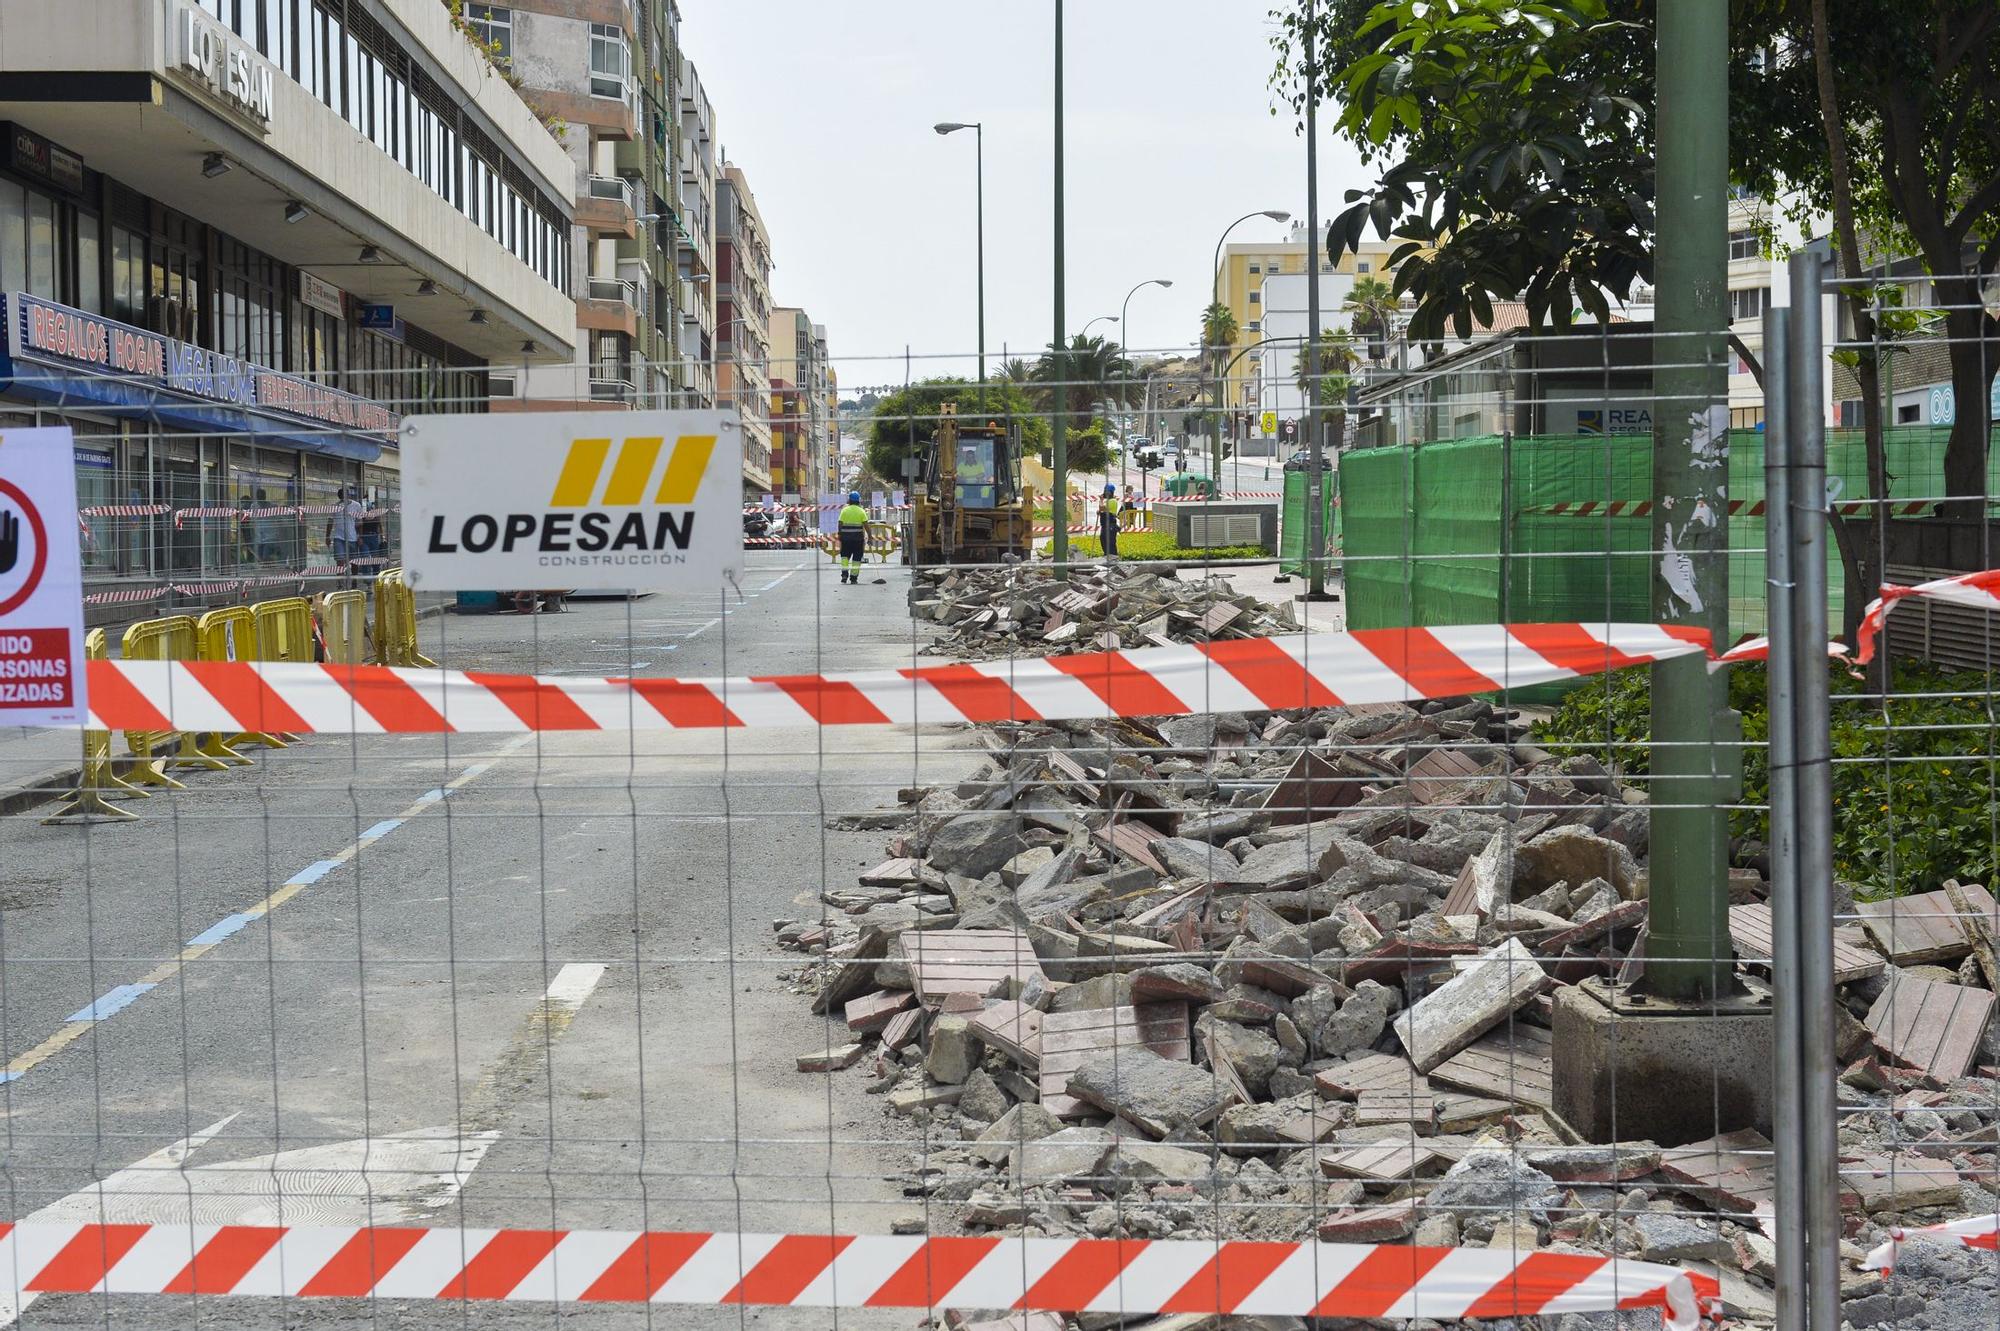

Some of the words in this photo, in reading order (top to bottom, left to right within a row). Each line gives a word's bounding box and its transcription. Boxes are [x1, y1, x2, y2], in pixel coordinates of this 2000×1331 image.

[33, 304, 108, 365] REGALOS
[114, 328, 164, 378] HOGAR
[172, 338, 215, 398] MEGA
[217, 356, 257, 408] HOME
[428, 511, 695, 554] LOPESAN
[538, 552, 686, 566] CONSTRUCCIÓN
